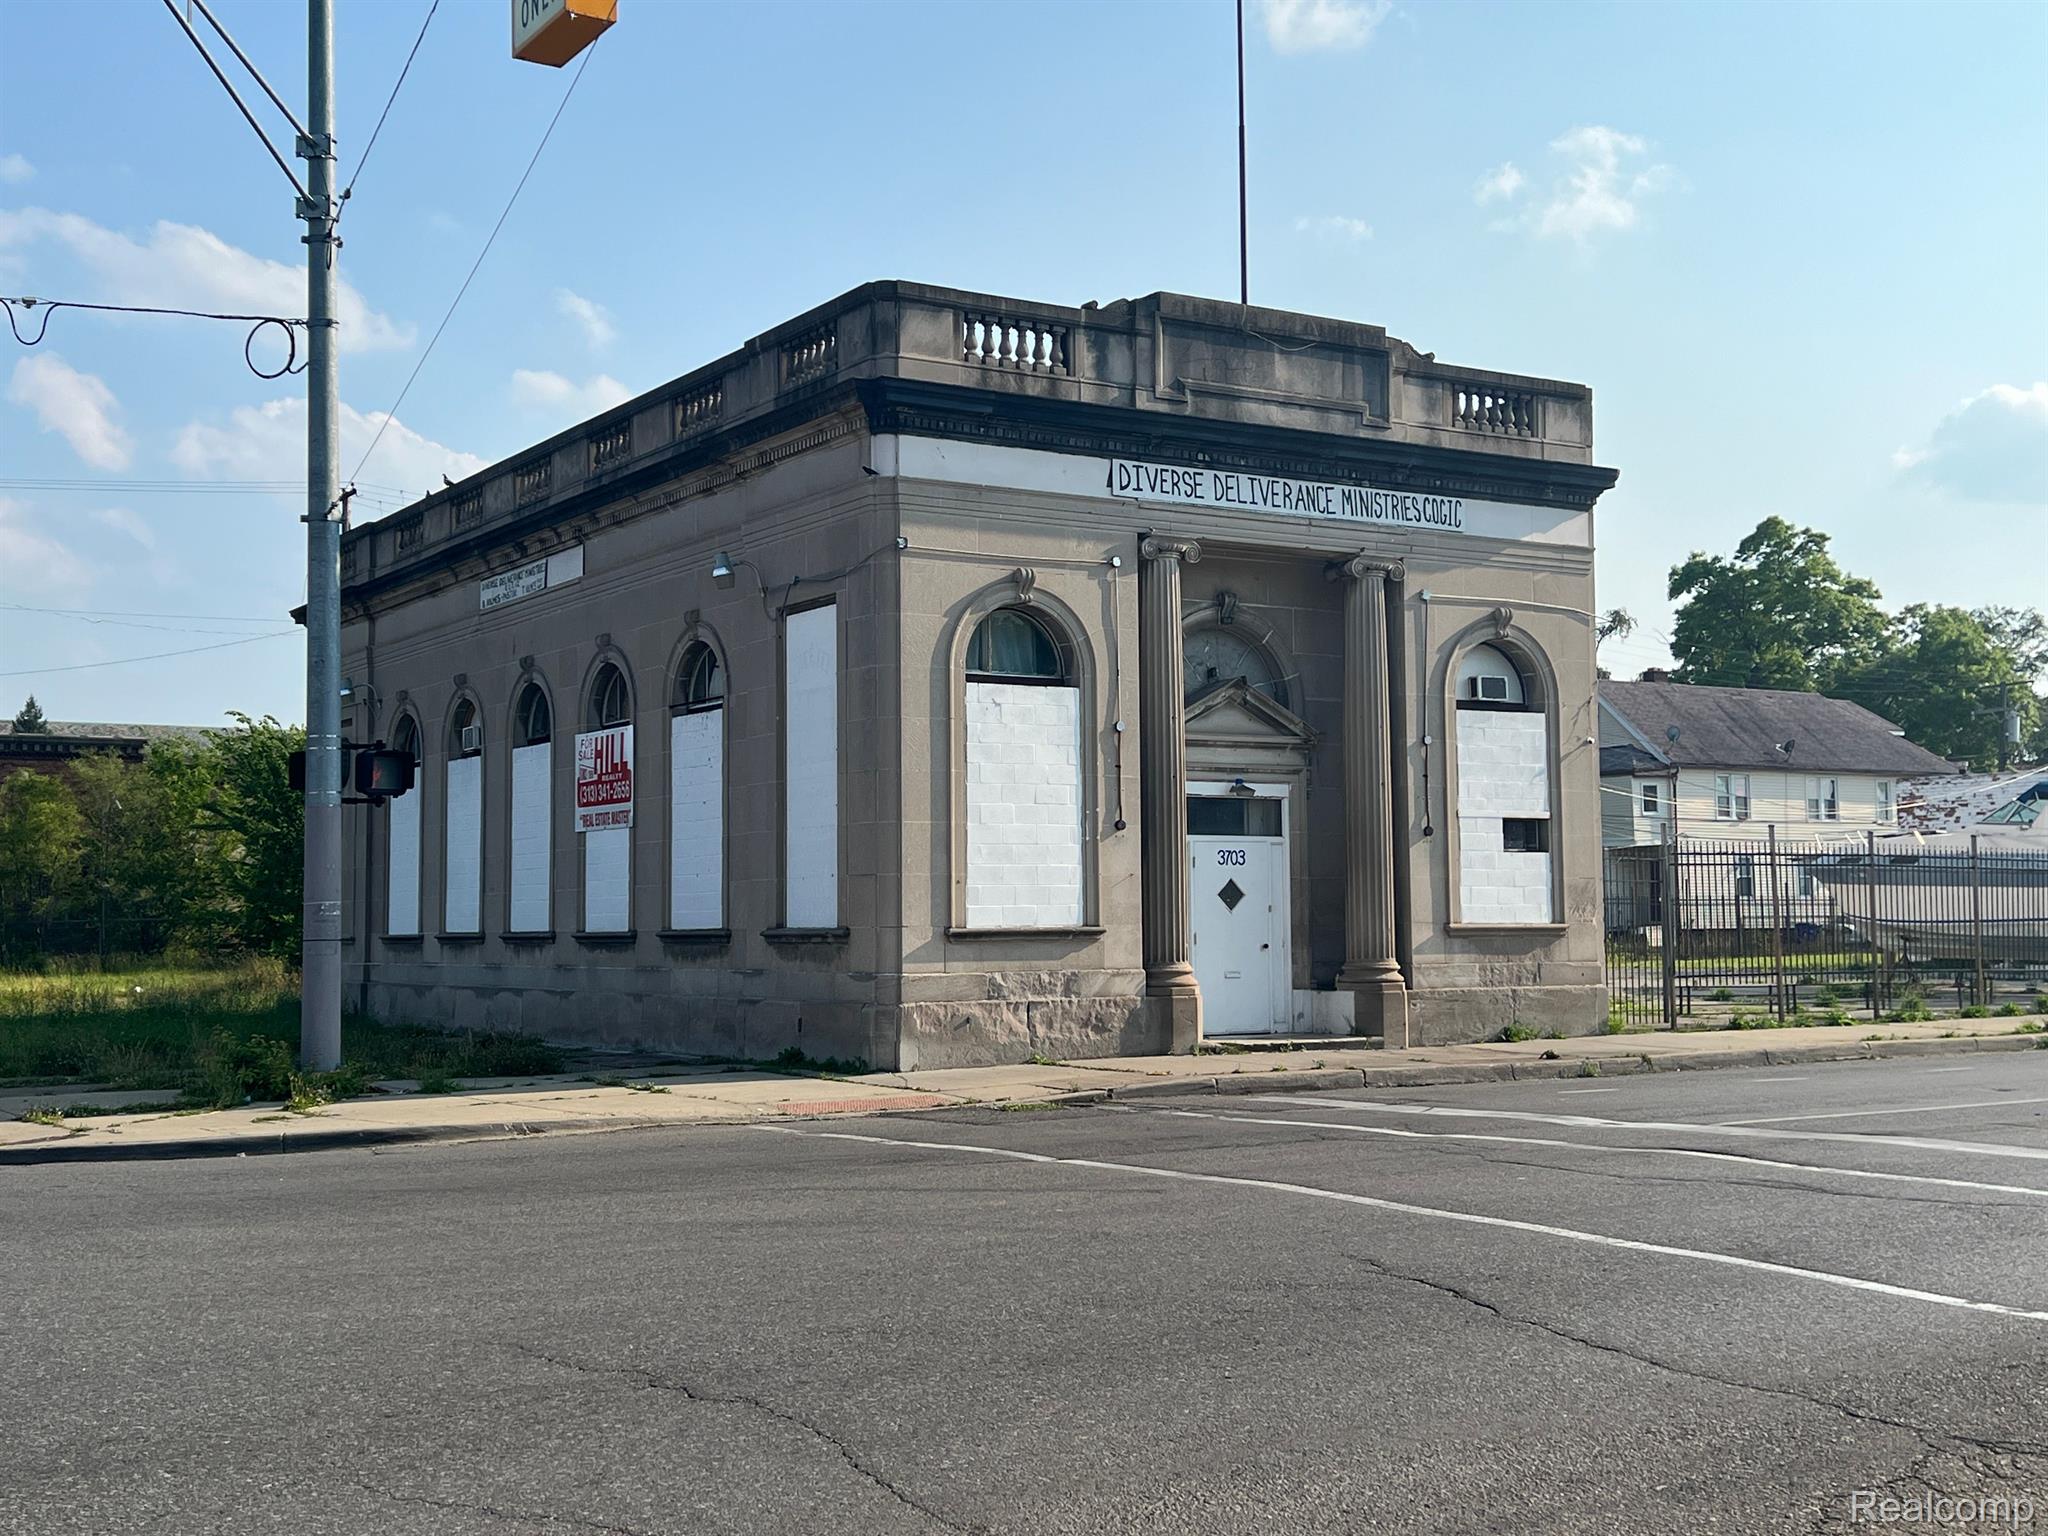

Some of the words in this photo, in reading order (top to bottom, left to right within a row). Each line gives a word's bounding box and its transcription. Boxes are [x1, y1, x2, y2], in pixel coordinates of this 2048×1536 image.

[1119, 463, 1205, 500] DIVERSE
[1213, 473, 1336, 515] DELIVERANCE
[581, 737, 593, 749] FOR
[578, 749, 594, 761] SALE
[595, 732, 628, 774] HILL
[601, 773, 623, 782] REALTY
[1217, 849, 1246, 866] 3703
